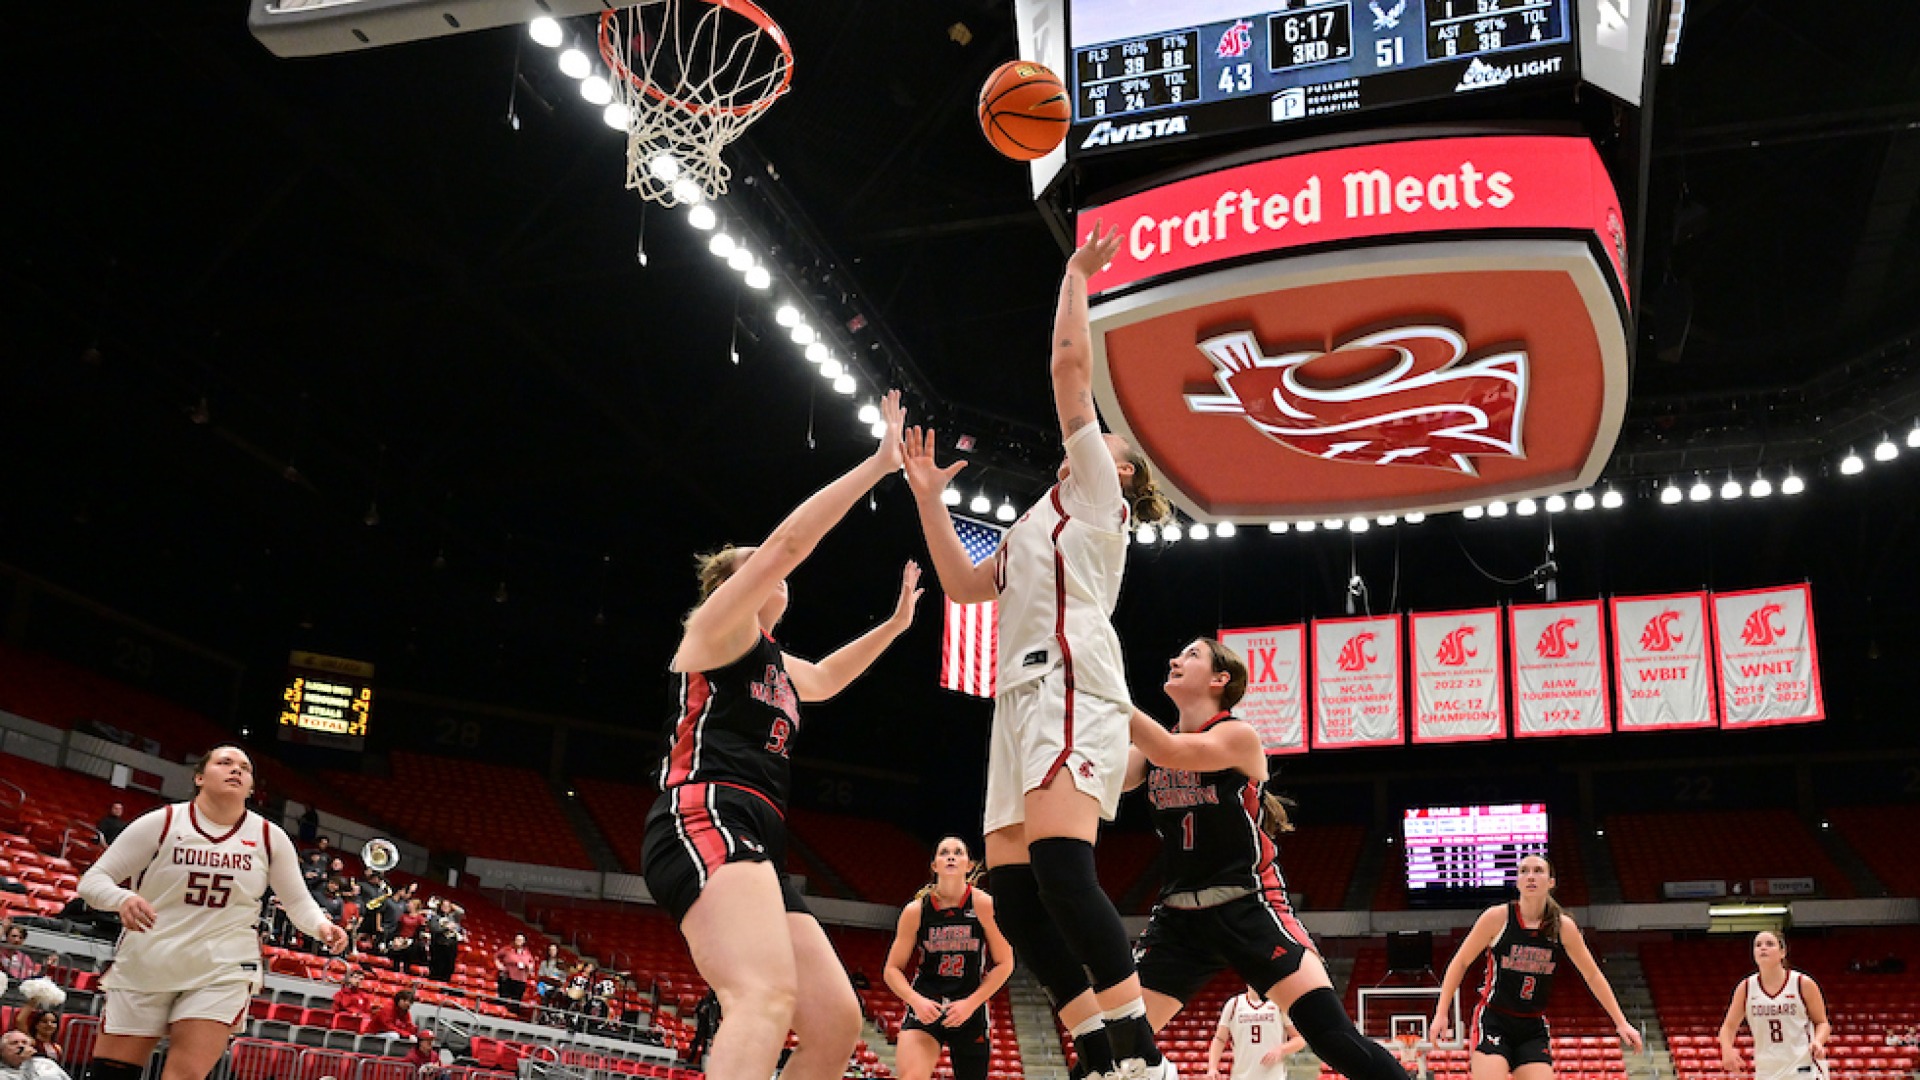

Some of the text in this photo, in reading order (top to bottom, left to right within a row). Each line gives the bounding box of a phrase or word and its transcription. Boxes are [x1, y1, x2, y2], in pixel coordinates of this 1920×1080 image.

[1284, 12, 1334, 42] 6:17
[1438, 24, 1460, 41] AST
[1521, 9, 1548, 24] TOL
[1530, 24, 1542, 42] 4
[1088, 34, 1187, 63] FLS FG% FT%
[1292, 41, 1329, 64] 3RD
[1376, 36, 1404, 67] 51
[1513, 56, 1562, 78] LIGHT
[1088, 84, 1109, 99] AST
[1164, 72, 1187, 87] TOL
[1218, 62, 1254, 93] 43
[1306, 78, 1360, 93] PULLMAN
[1125, 92, 1145, 110] 24
[1307, 90, 1360, 104] REGIONAL
[1308, 101, 1361, 116] HOSPITAL
[1081, 116, 1187, 149] AVISTA
[1129, 160, 1515, 261] Crafted Meats
[1247, 637, 1277, 647] TITLE
[1246, 646, 1279, 685] IX
[1639, 665, 1689, 682] WBIT
[1740, 659, 1795, 678] WNIT
[1247, 683, 1290, 694] ONEERS
[1339, 683, 1374, 694] NCAA
[1541, 679, 1578, 689] AIAW
[1321, 693, 1393, 704] TOURNAMENT
[1522, 688, 1597, 701] TOURNAMENT
[1631, 689, 1661, 699] 2024
[1433, 698, 1483, 711] PAC-12
[303, 717, 343, 730] TOTAL
[1420, 710, 1498, 724] CHAMPIONS
[1543, 709, 1581, 722] 1972
[1181, 811, 1193, 851] 1
[172, 846, 252, 871] COUGARS
[184, 871, 233, 908] 55
[938, 954, 964, 977] 22
[1520, 976, 1536, 1000] 2
[1238, 1013, 1275, 1023] COUGARS
[1751, 1003, 1797, 1016] COUGARS
[1251, 1024, 1261, 1044] 9
[1768, 1019, 1783, 1043] 8
